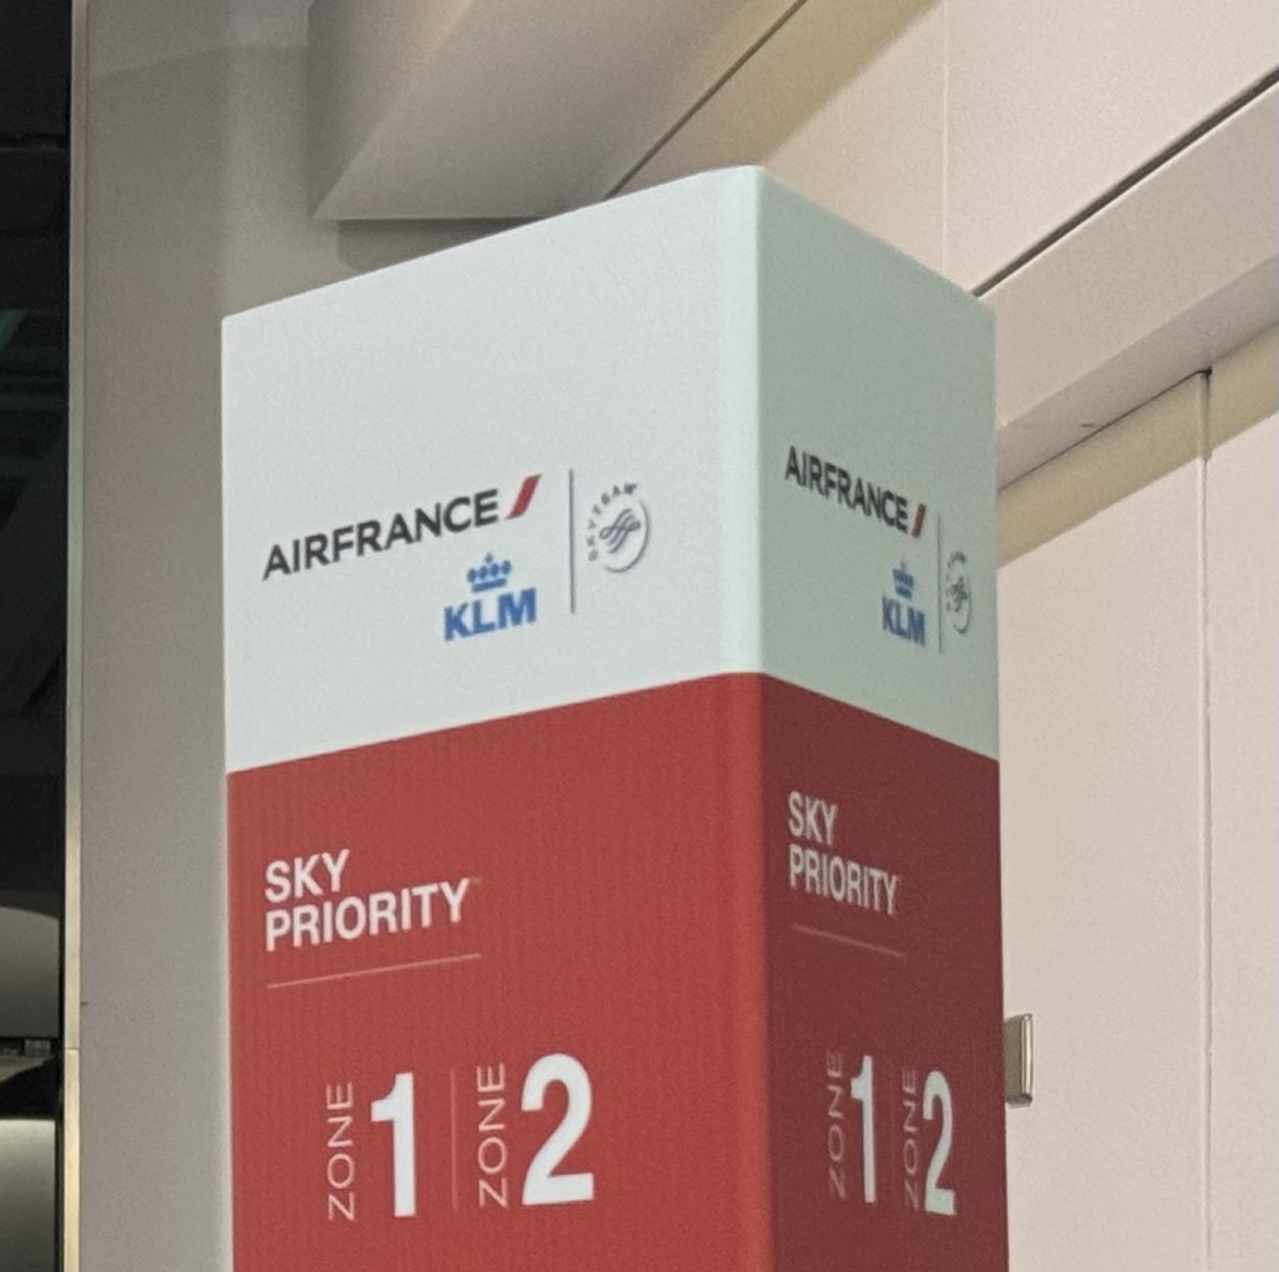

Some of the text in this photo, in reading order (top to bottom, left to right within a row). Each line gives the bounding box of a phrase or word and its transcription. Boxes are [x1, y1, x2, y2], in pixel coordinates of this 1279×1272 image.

[783, 445, 909, 534] AIRFRANCE
[262, 487, 500, 581] AIRFRANCE
[444, 586, 538, 642] KLM
[882, 594, 926, 648] KLM
[788, 790, 838, 844] SKY
[264, 849, 351, 904] SKY
[265, 876, 470, 953] PRIORITY
[789, 843, 898, 916] PRIORITY
[326, 1072, 417, 1222] ZONE 1
[476, 1053, 595, 1209] ZONE 2
[827, 1050, 876, 1204] ZONE 1
[903, 1065, 957, 1216] ZONE 2
